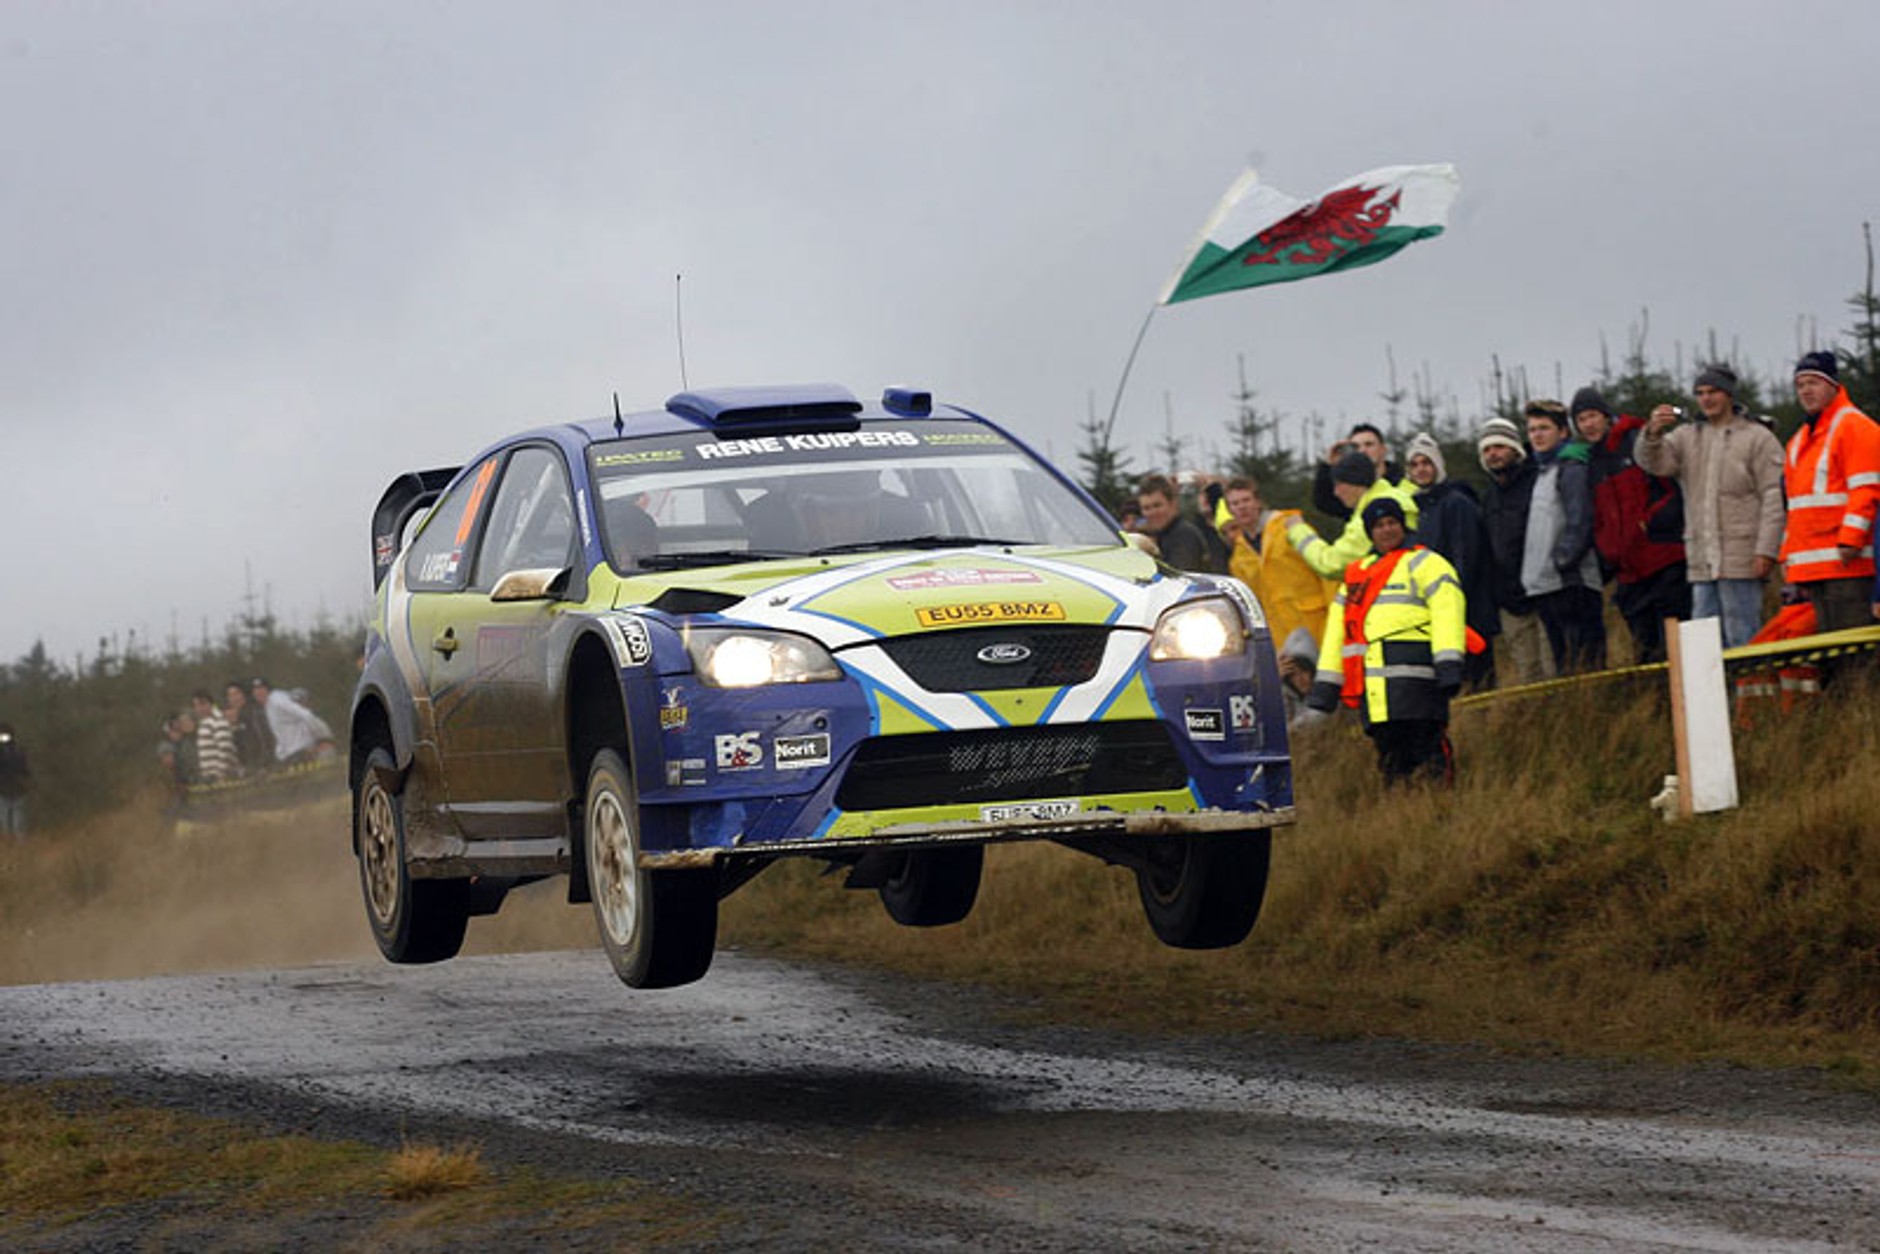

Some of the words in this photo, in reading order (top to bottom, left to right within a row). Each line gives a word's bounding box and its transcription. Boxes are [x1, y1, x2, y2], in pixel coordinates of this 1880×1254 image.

[695, 437, 784, 459] RENE
[785, 432, 919, 450] KUIPERS
[928, 604, 993, 621] EU55
[776, 741, 816, 758] Norit
